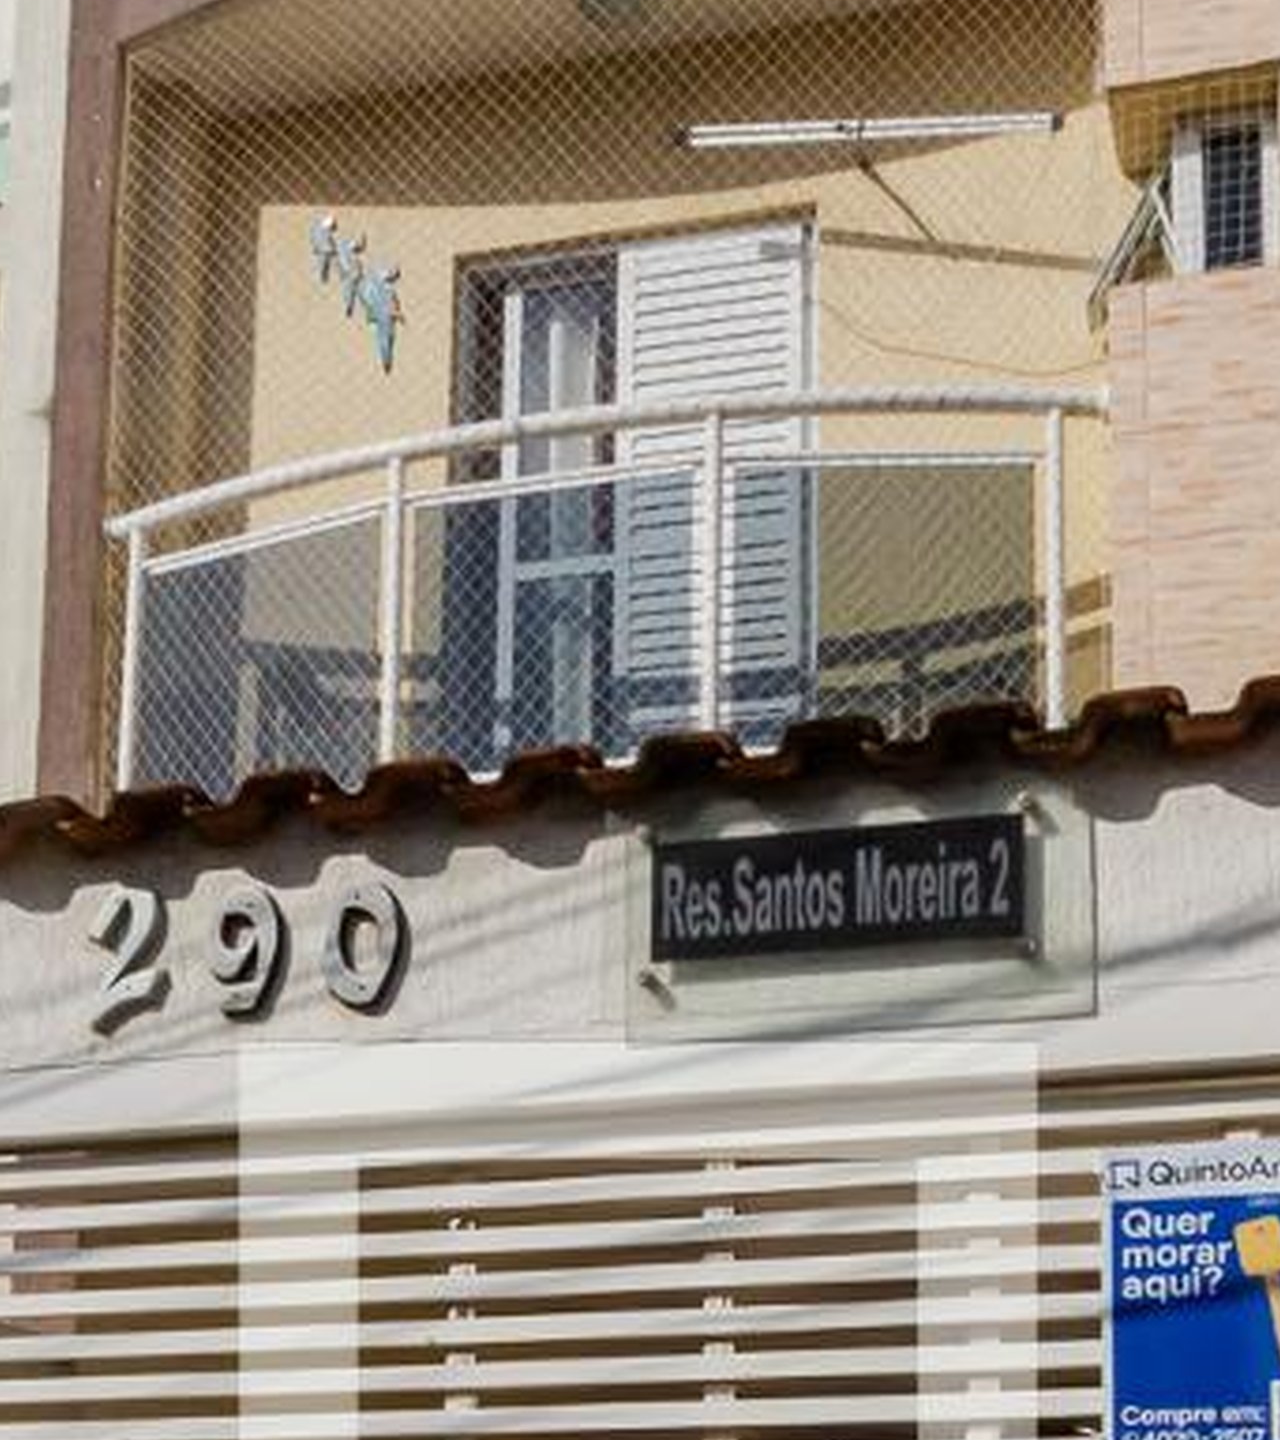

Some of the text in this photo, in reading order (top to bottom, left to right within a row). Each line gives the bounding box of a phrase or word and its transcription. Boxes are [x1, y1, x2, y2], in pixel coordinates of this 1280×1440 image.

[854, 842, 979, 926] Moreira
[988, 839, 1010, 916] 2
[86, 880, 412, 1035] 290
[1121, 1208, 1215, 1239] Quer
[1121, 1240, 1233, 1269] morar
[1121, 1266, 1224, 1303] aqui?
[1121, 1406, 1218, 1427] Compre
